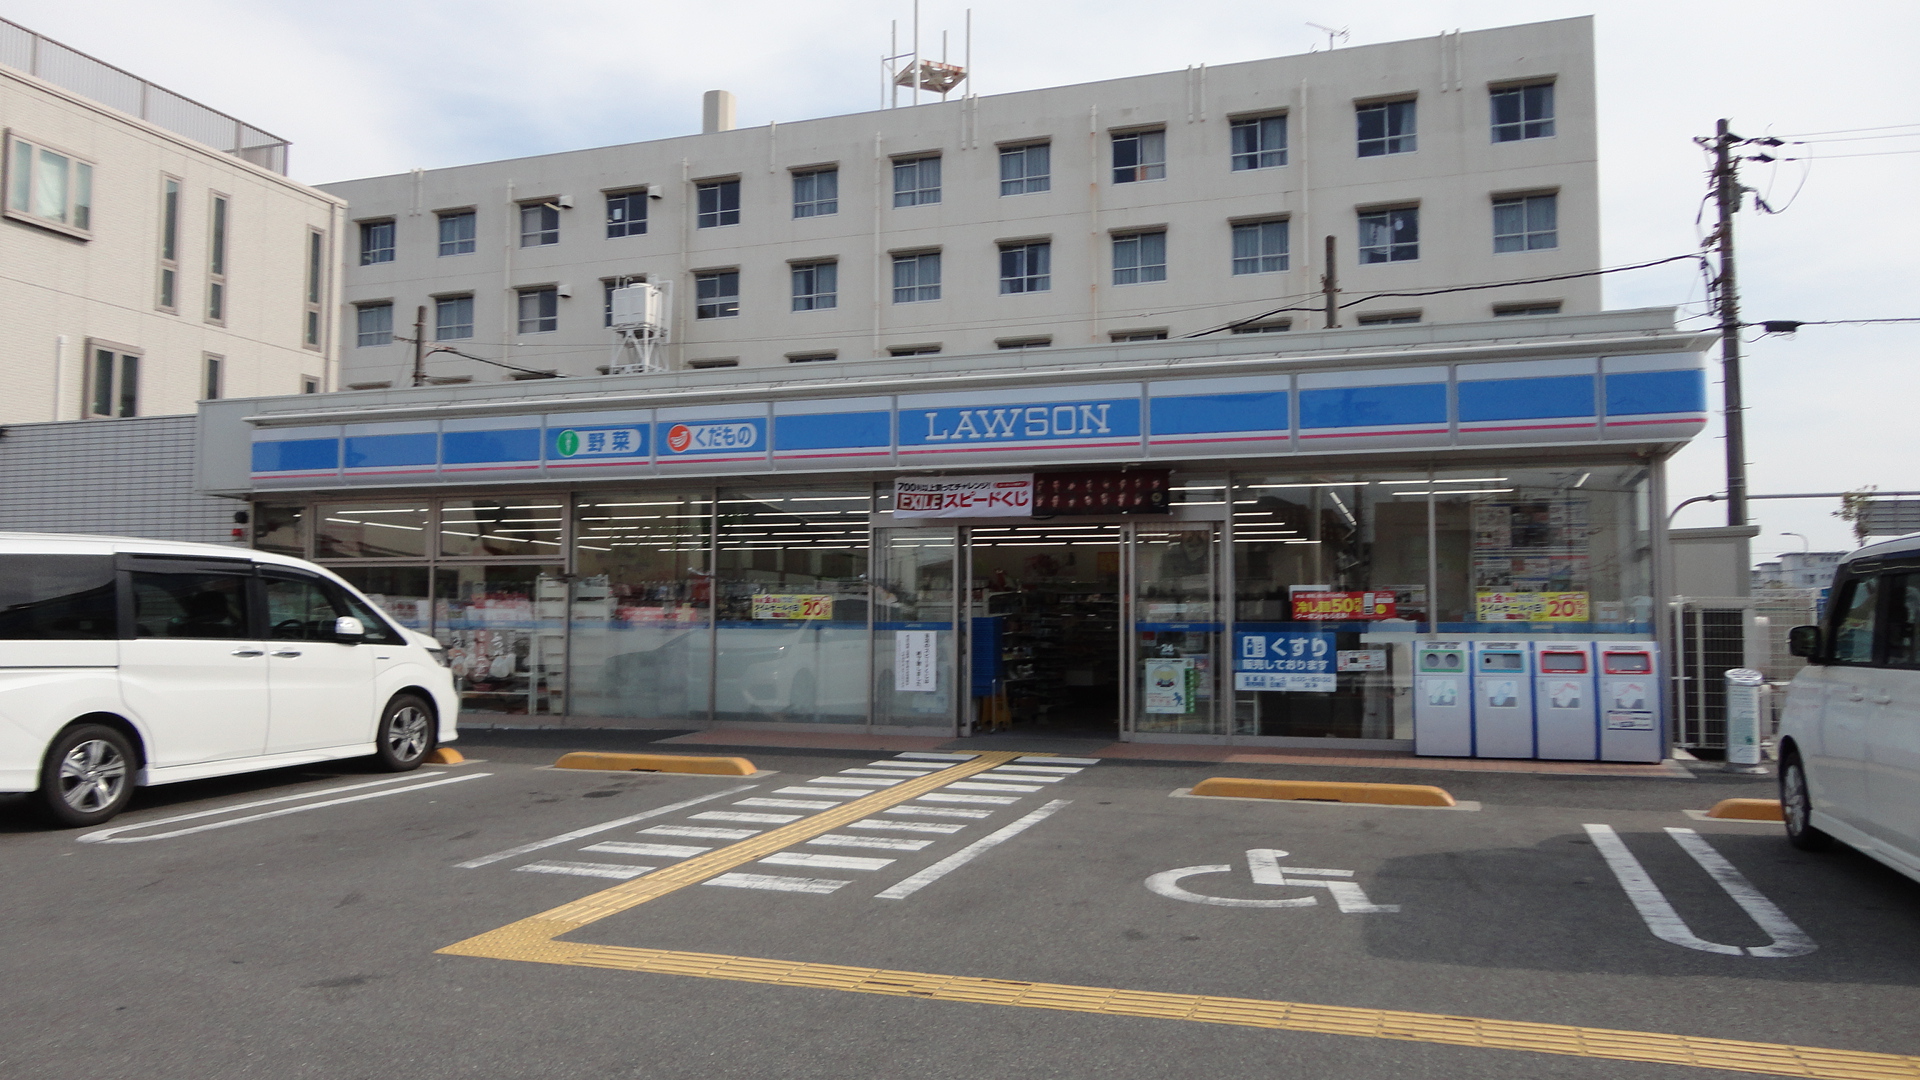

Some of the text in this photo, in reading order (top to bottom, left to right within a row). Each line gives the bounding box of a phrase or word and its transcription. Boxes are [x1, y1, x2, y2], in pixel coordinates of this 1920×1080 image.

[925, 404, 1111, 441] LAWSON
[587, 431, 630, 452] 野菜
[695, 426, 752, 447] くだもの
[899, 491, 1029, 510] EXILE スピードくじ
[803, 602, 823, 616] 20
[1548, 600, 1575, 617] 20
[1270, 637, 1329, 657] くすり
[1242, 659, 1329, 671] 販売しております
